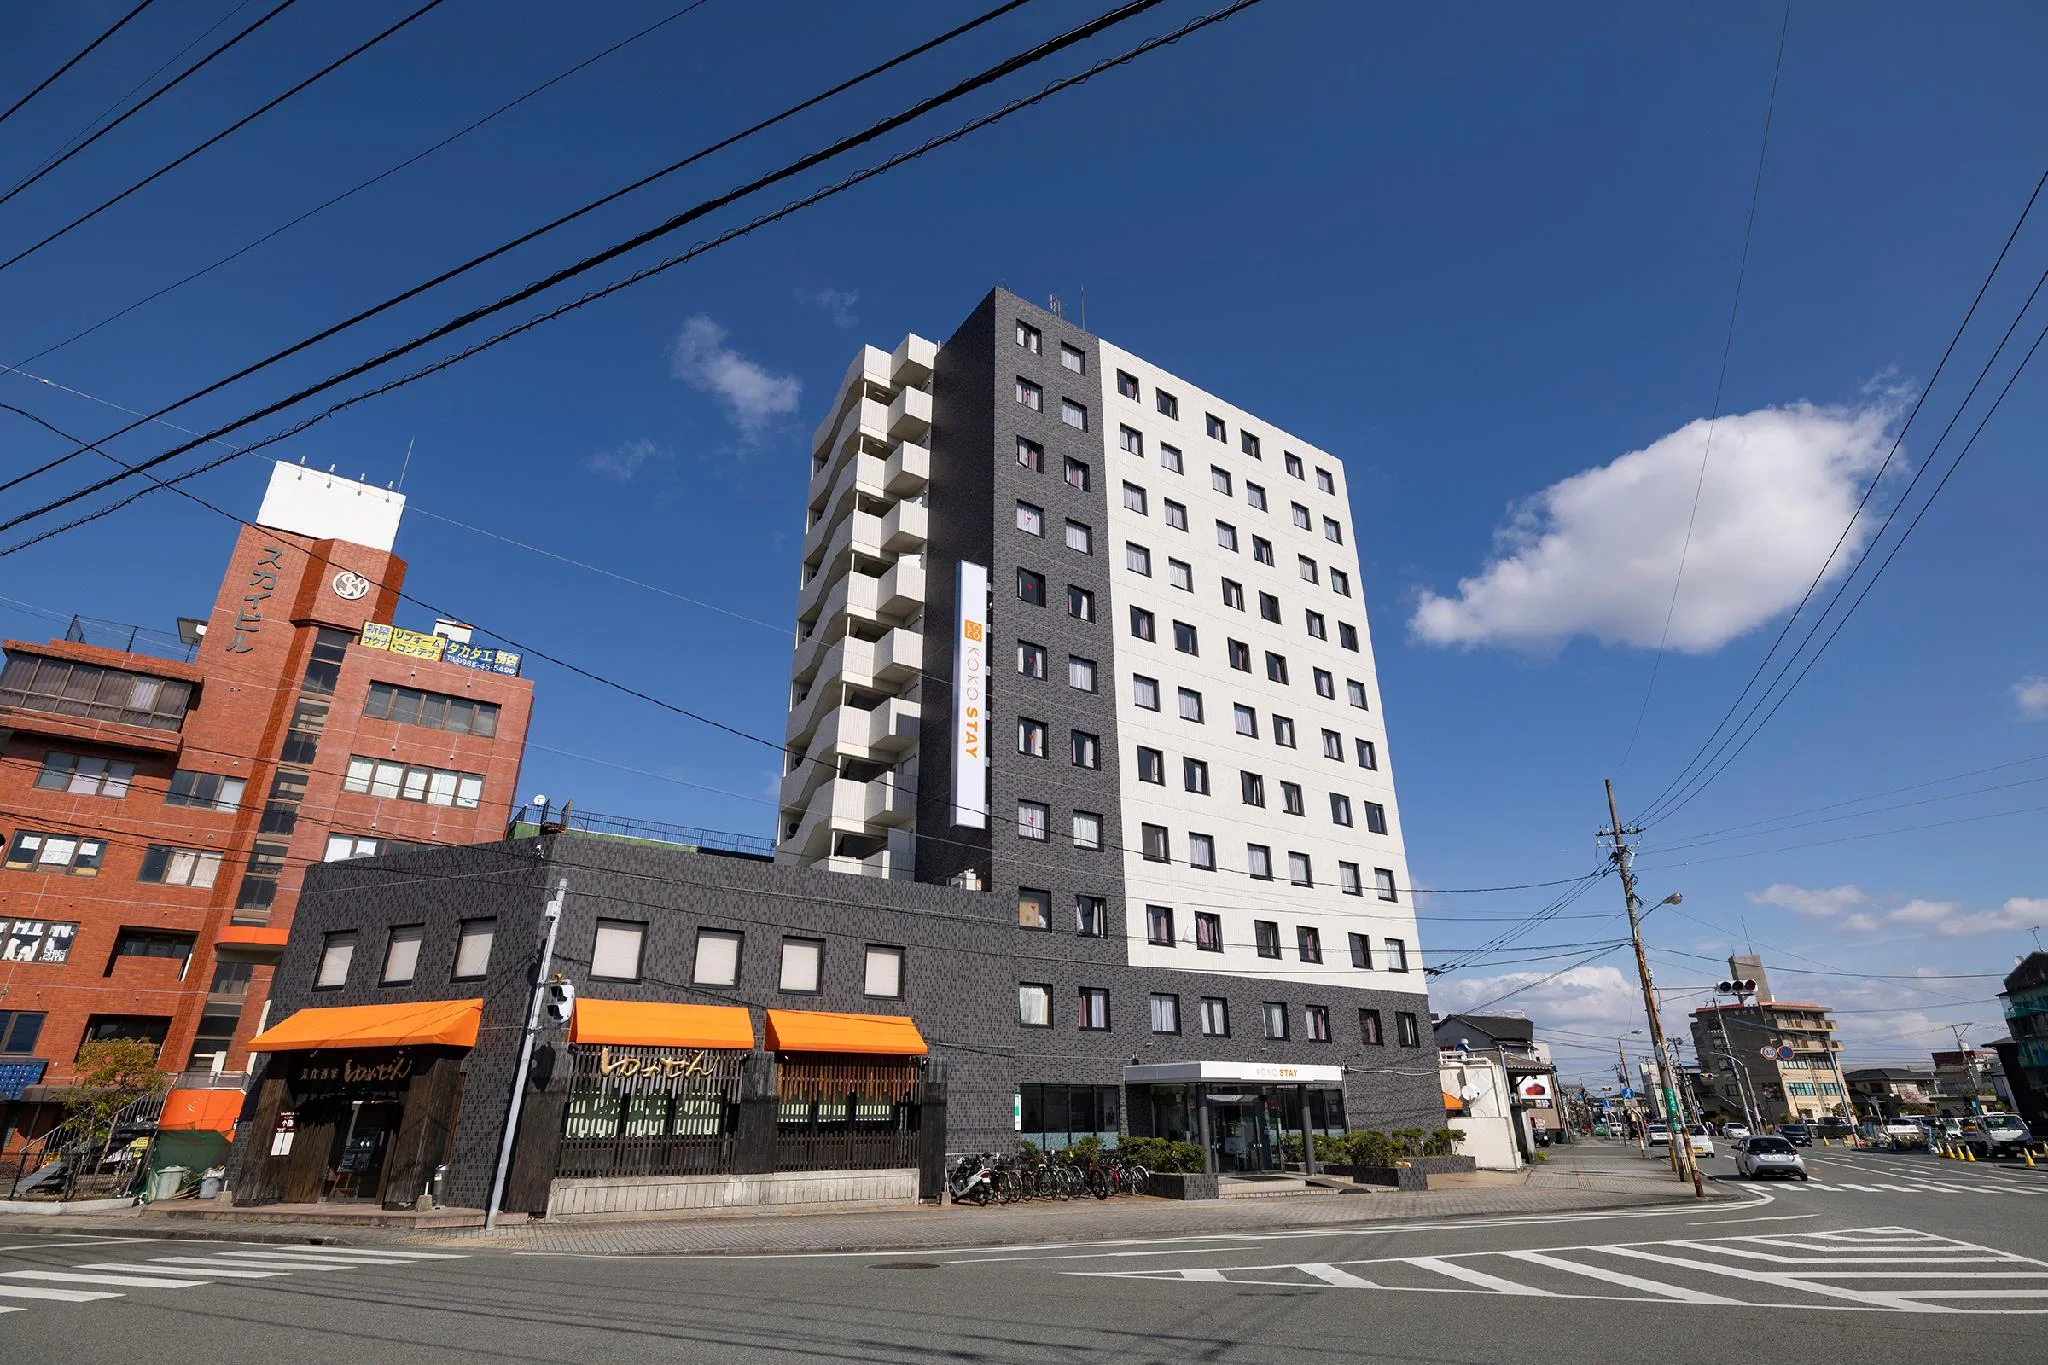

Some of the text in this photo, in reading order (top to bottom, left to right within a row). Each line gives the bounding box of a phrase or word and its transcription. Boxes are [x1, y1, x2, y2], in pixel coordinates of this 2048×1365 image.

[225, 546, 284, 653] スカイビル
[395, 629, 441, 648] リフォーム
[966, 646, 979, 701] KOKO
[965, 706, 979, 759] STAY
[1279, 1069, 1297, 1077] STAY
